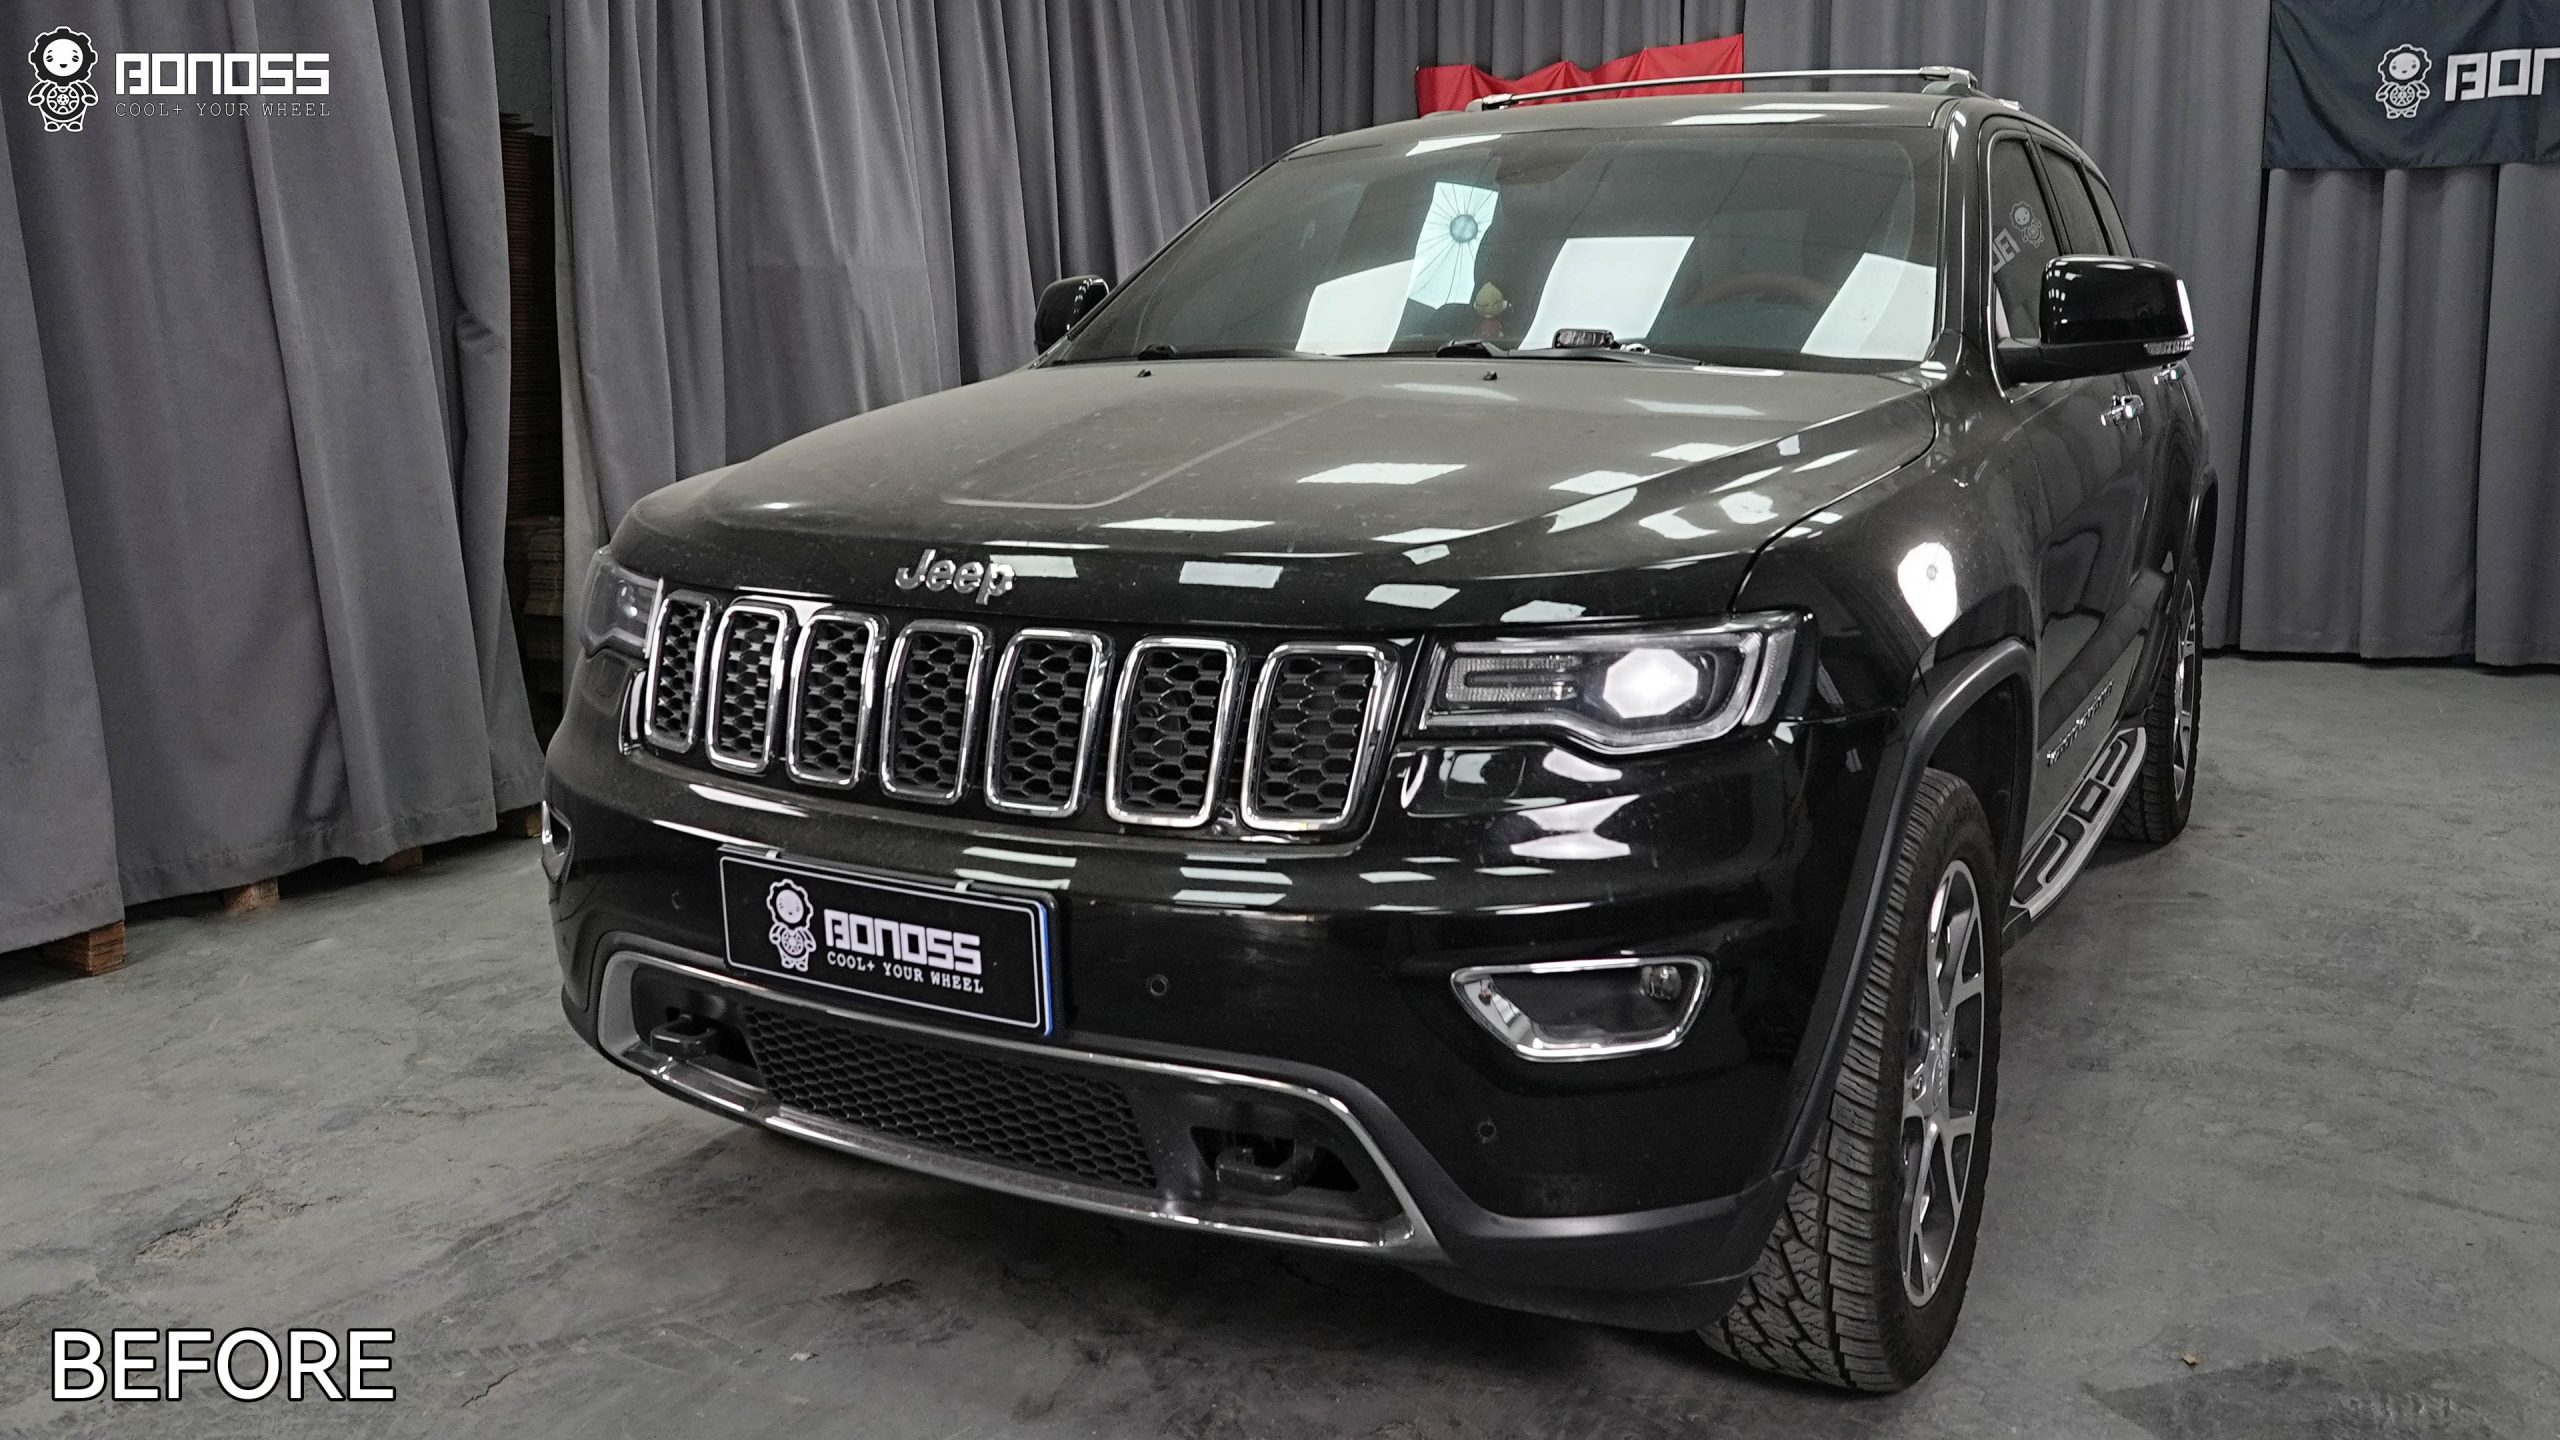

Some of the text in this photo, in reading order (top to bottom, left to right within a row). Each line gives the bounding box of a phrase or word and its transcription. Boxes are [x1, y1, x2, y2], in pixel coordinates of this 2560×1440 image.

[895, 549, 1015, 605] Jeep
[824, 909, 982, 975] BONOSS
[827, 951, 984, 994] COOL+ YOUR WHEEL
